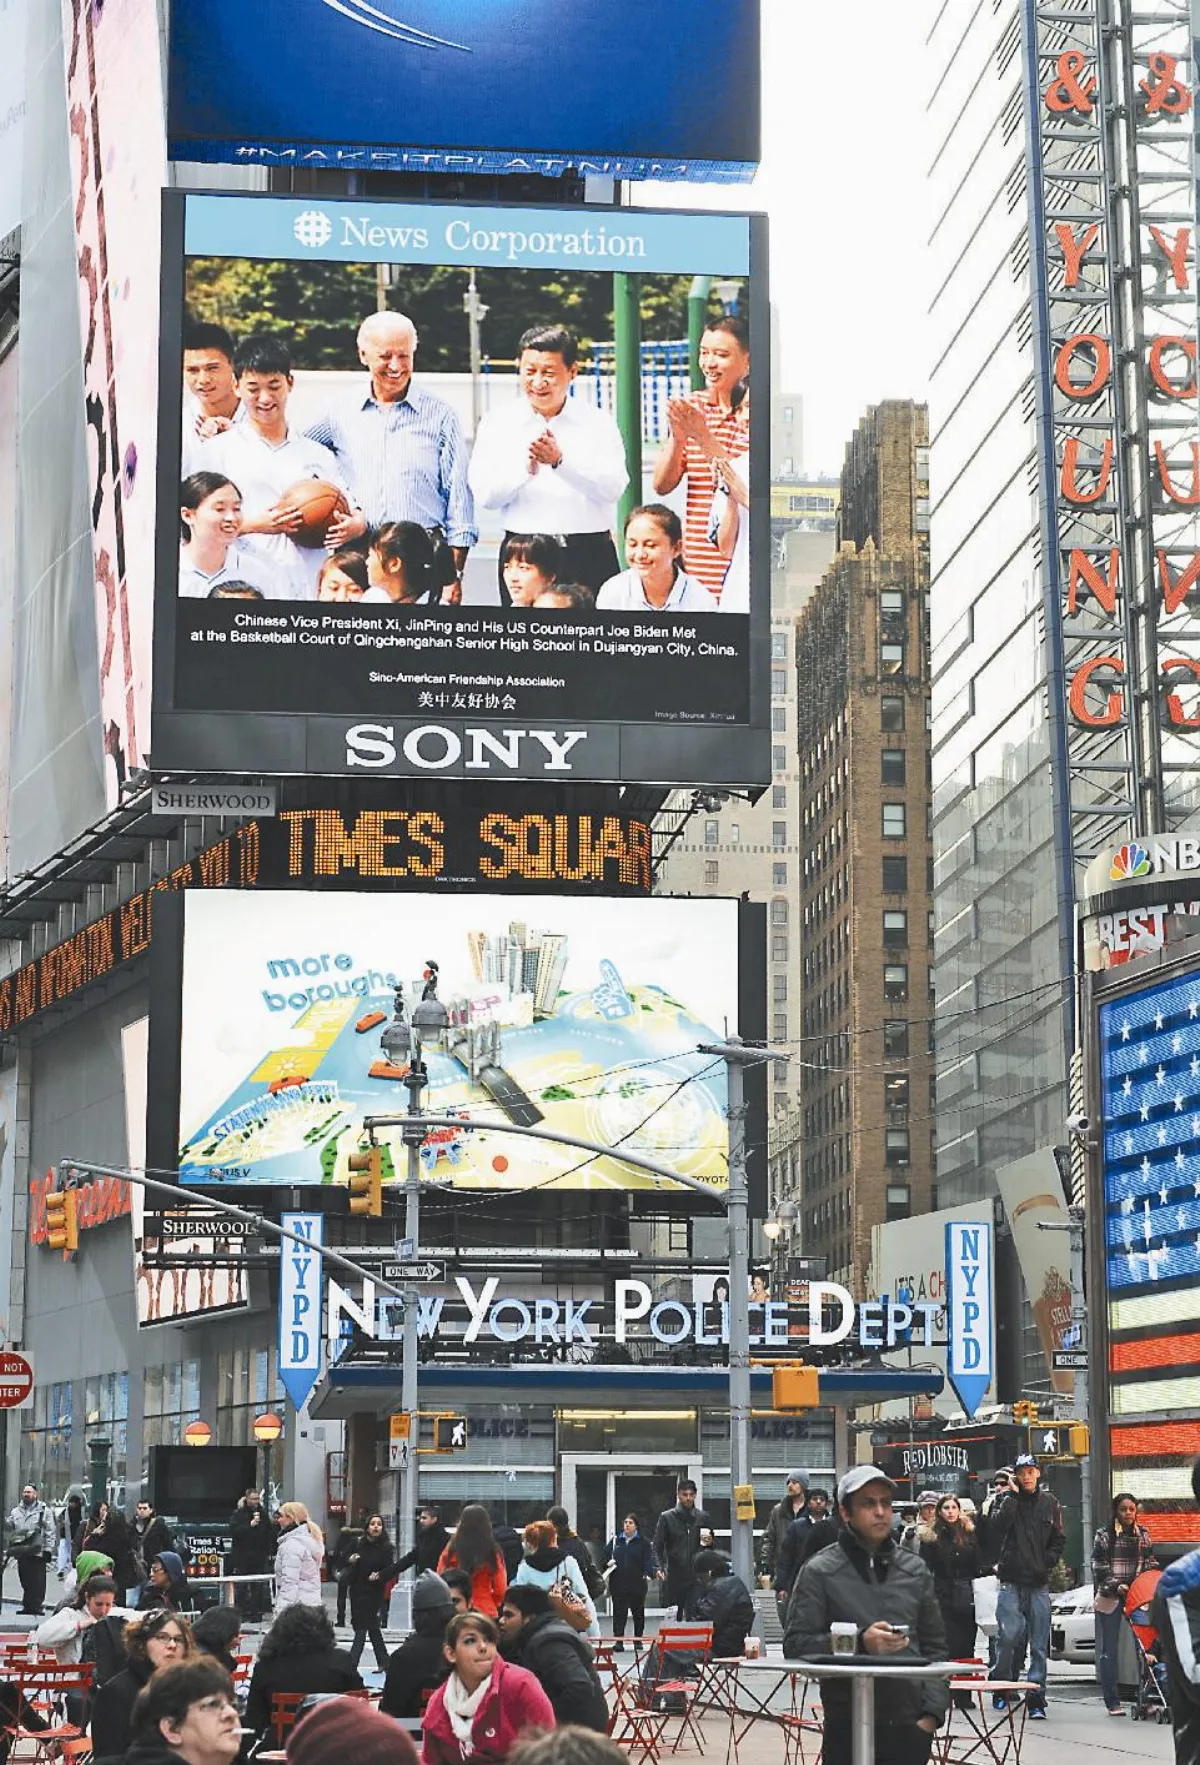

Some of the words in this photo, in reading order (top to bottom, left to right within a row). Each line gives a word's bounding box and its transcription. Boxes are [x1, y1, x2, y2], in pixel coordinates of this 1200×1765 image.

[340, 216, 429, 249] News
[445, 219, 647, 260] Corporation
[234, 614, 287, 628] Chinese
[290, 615, 319, 628] Vice
[322, 616, 382, 630] President
[385, 618, 402, 632] Xi,
[406, 618, 452, 634] JinPing
[455, 621, 479, 633] and
[483, 621, 504, 634] His
[507, 622, 526, 634] US
[530, 623, 604, 637] Counterpart
[607, 624, 630, 637] Joe
[634, 625, 669, 638] Biden
[672, 626, 696, 639] Met
[190, 629, 204, 641] at
[207, 630, 227, 642] the
[230, 631, 297, 644] Basketball
[300, 632, 335, 645] Court
[338, 633, 351, 645] of
[456, 637, 496, 650] Senior
[500, 638, 529, 652] High
[532, 639, 576, 652] School
[579, 640, 590, 652] in
[593, 640, 664, 655] Dujiangyan
[666, 642, 695, 656] City,
[698, 643, 739, 657] China.
[369, 671, 447, 684] Sino-American
[449, 674, 504, 687] Friendship
[506, 675, 566, 688] Association
[418, 691, 517, 710] 美中友好协会
[345, 722, 588, 771] SONY
[157, 791, 271, 810] SHERWOOD
[279, 809, 445, 877] TIMES
[266, 953, 353, 979] more
[261, 969, 398, 1012] boroughs
[390, 1266, 409, 1276] ONE
[416, 1266, 436, 1276] WAY
[290, 1220, 312, 1365] NYPD
[959, 1228, 981, 1370] NYPD
[455, 1277, 593, 1346] YORK
[809, 1281, 942, 1347] DEPT
[4, 1362, 24, 1372] NOT
[1060, 1356, 1078, 1365] ONE
[0, 1387, 21, 1397] TER
[466, 1418, 529, 1439] OLICE
[747, 1419, 810, 1440] OLICE
[926, 1443, 969, 1472] LOBSTER
[187, 1536, 212, 1546] Times
